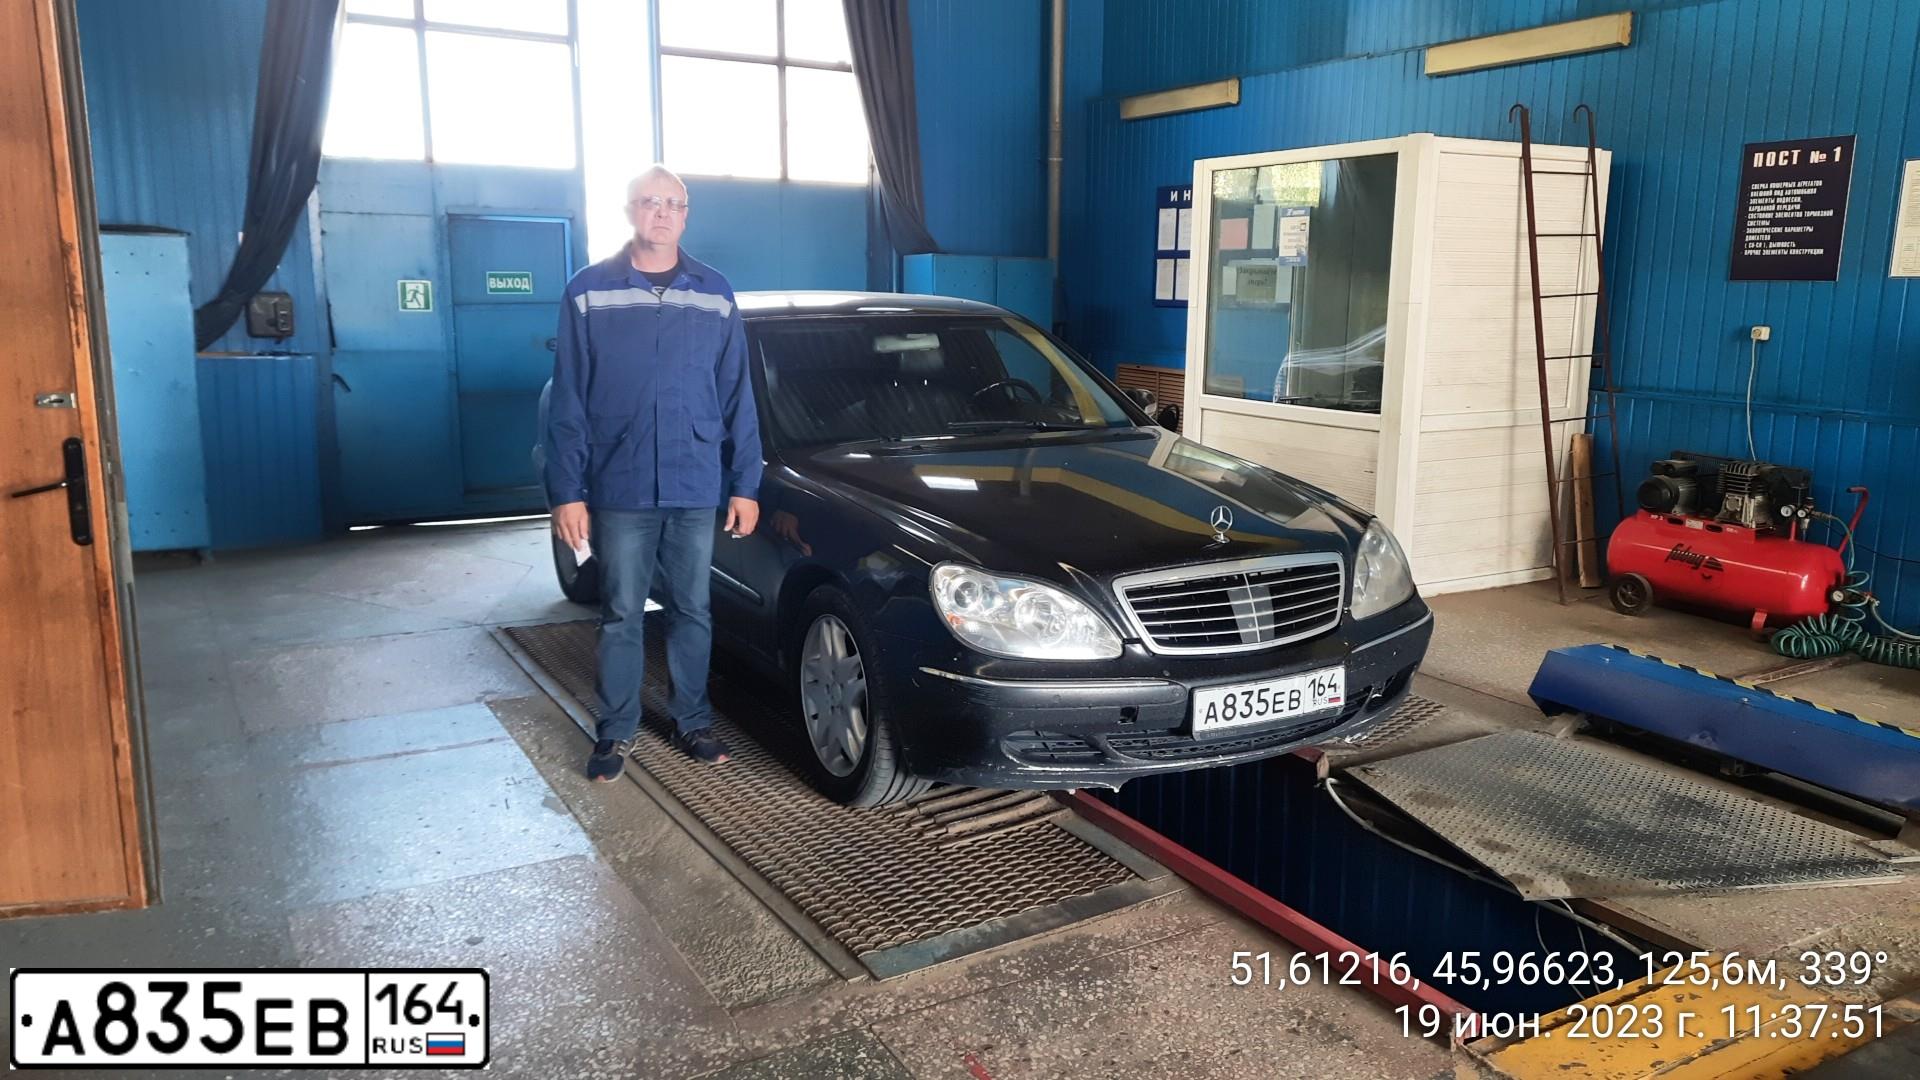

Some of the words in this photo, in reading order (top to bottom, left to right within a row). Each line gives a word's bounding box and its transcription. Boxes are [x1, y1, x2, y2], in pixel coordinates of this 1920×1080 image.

[1753, 149, 1802, 168] ПОСТ
[1809, 150, 1827, 164] №
[1833, 146, 1842, 162] 1
[488, 277, 530, 291] ВЫХОД
[1307, 673, 1338, 699] 164
[1204, 687, 1301, 725] А835ЕВ
[1312, 696, 1328, 707] RUS
